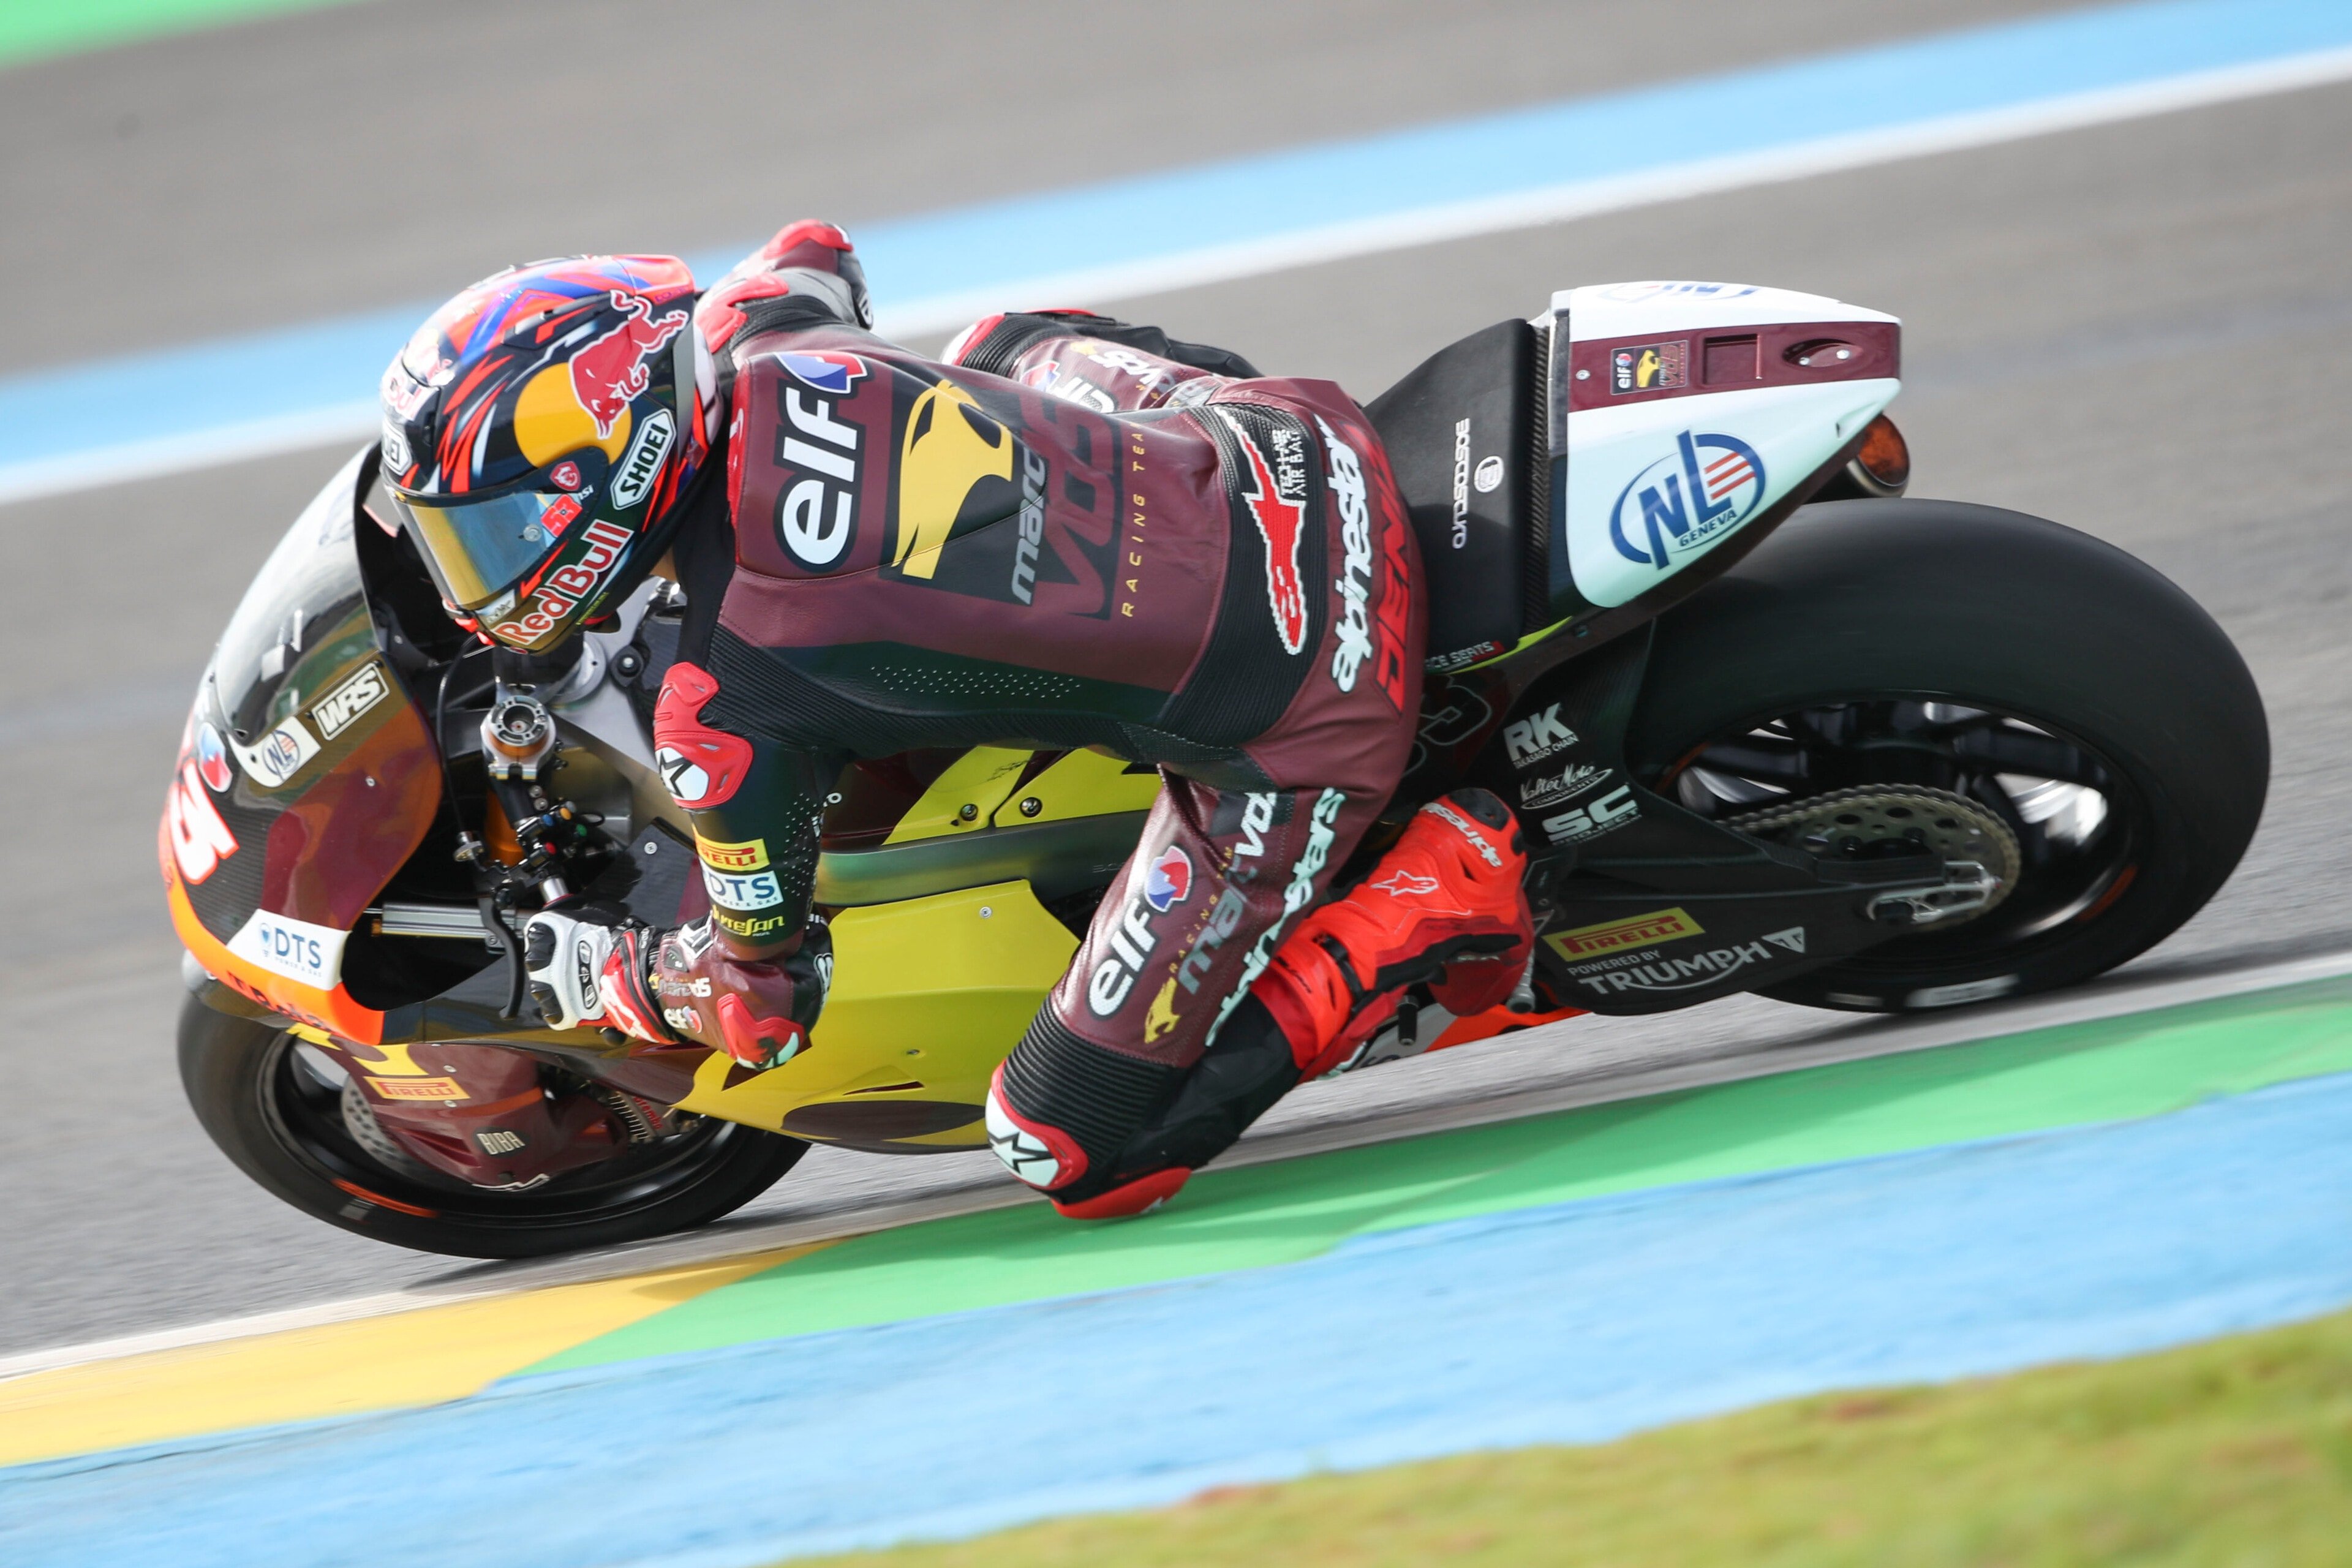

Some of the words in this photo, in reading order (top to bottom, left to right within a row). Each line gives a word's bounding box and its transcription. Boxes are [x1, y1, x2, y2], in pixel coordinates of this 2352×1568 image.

[620, 423, 669, 497] SHOEI
[782, 386, 858, 565] elf
[1012, 447, 1046, 605] marc
[1121, 494, 1147, 617] RACING
[1678, 510, 1738, 547] GENEVA
[492, 587, 578, 645] Red
[550, 519, 634, 597] Bull
[1449, 641, 1496, 663] SEATS
[317, 669, 380, 734] WRS
[1502, 702, 1575, 762] RK
[1542, 784, 1638, 843] SC
[709, 872, 775, 902] DTS
[274, 927, 322, 969] DTS
[1090, 899, 1157, 1017] elf
[1559, 915, 1686, 954] PIRELLI
[1567, 954, 1641, 976] POWERED
[1642, 949, 1663, 963] BY
[1578, 941, 1773, 995] TRIUMPH
[375, 1081, 456, 1096] PIRELLI
